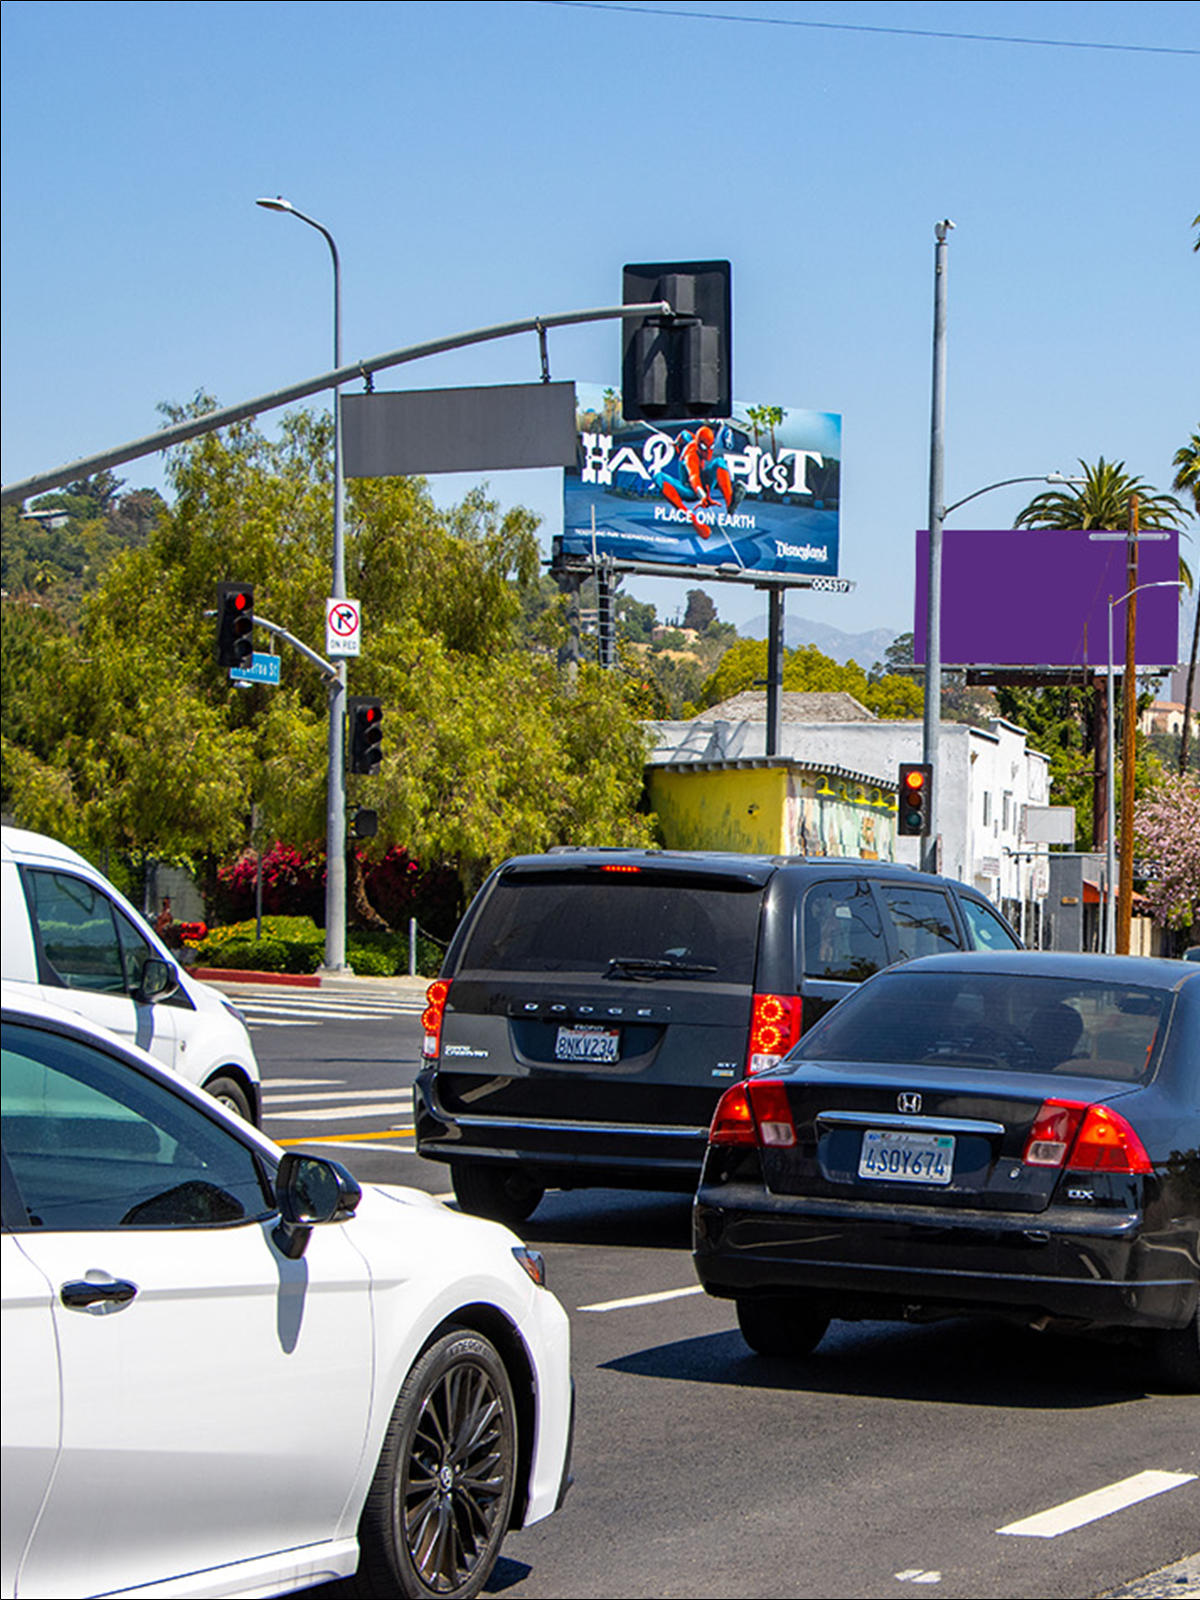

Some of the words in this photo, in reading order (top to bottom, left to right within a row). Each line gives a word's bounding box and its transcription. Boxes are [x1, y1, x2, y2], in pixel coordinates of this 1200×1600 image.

[654, 506, 693, 524] PLACE
[696, 510, 715, 526] ON
[717, 513, 756, 529] EARTH
[775, 540, 828, 562] Disneyland
[330, 639, 341, 649] ON
[343, 640, 357, 650] RED
[524, 1002, 652, 1016] DODGE
[574, 1024, 605, 1032] TROPHY
[557, 1035, 616, 1057] 8NKV234
[1068, 1189, 1094, 1200] DX
